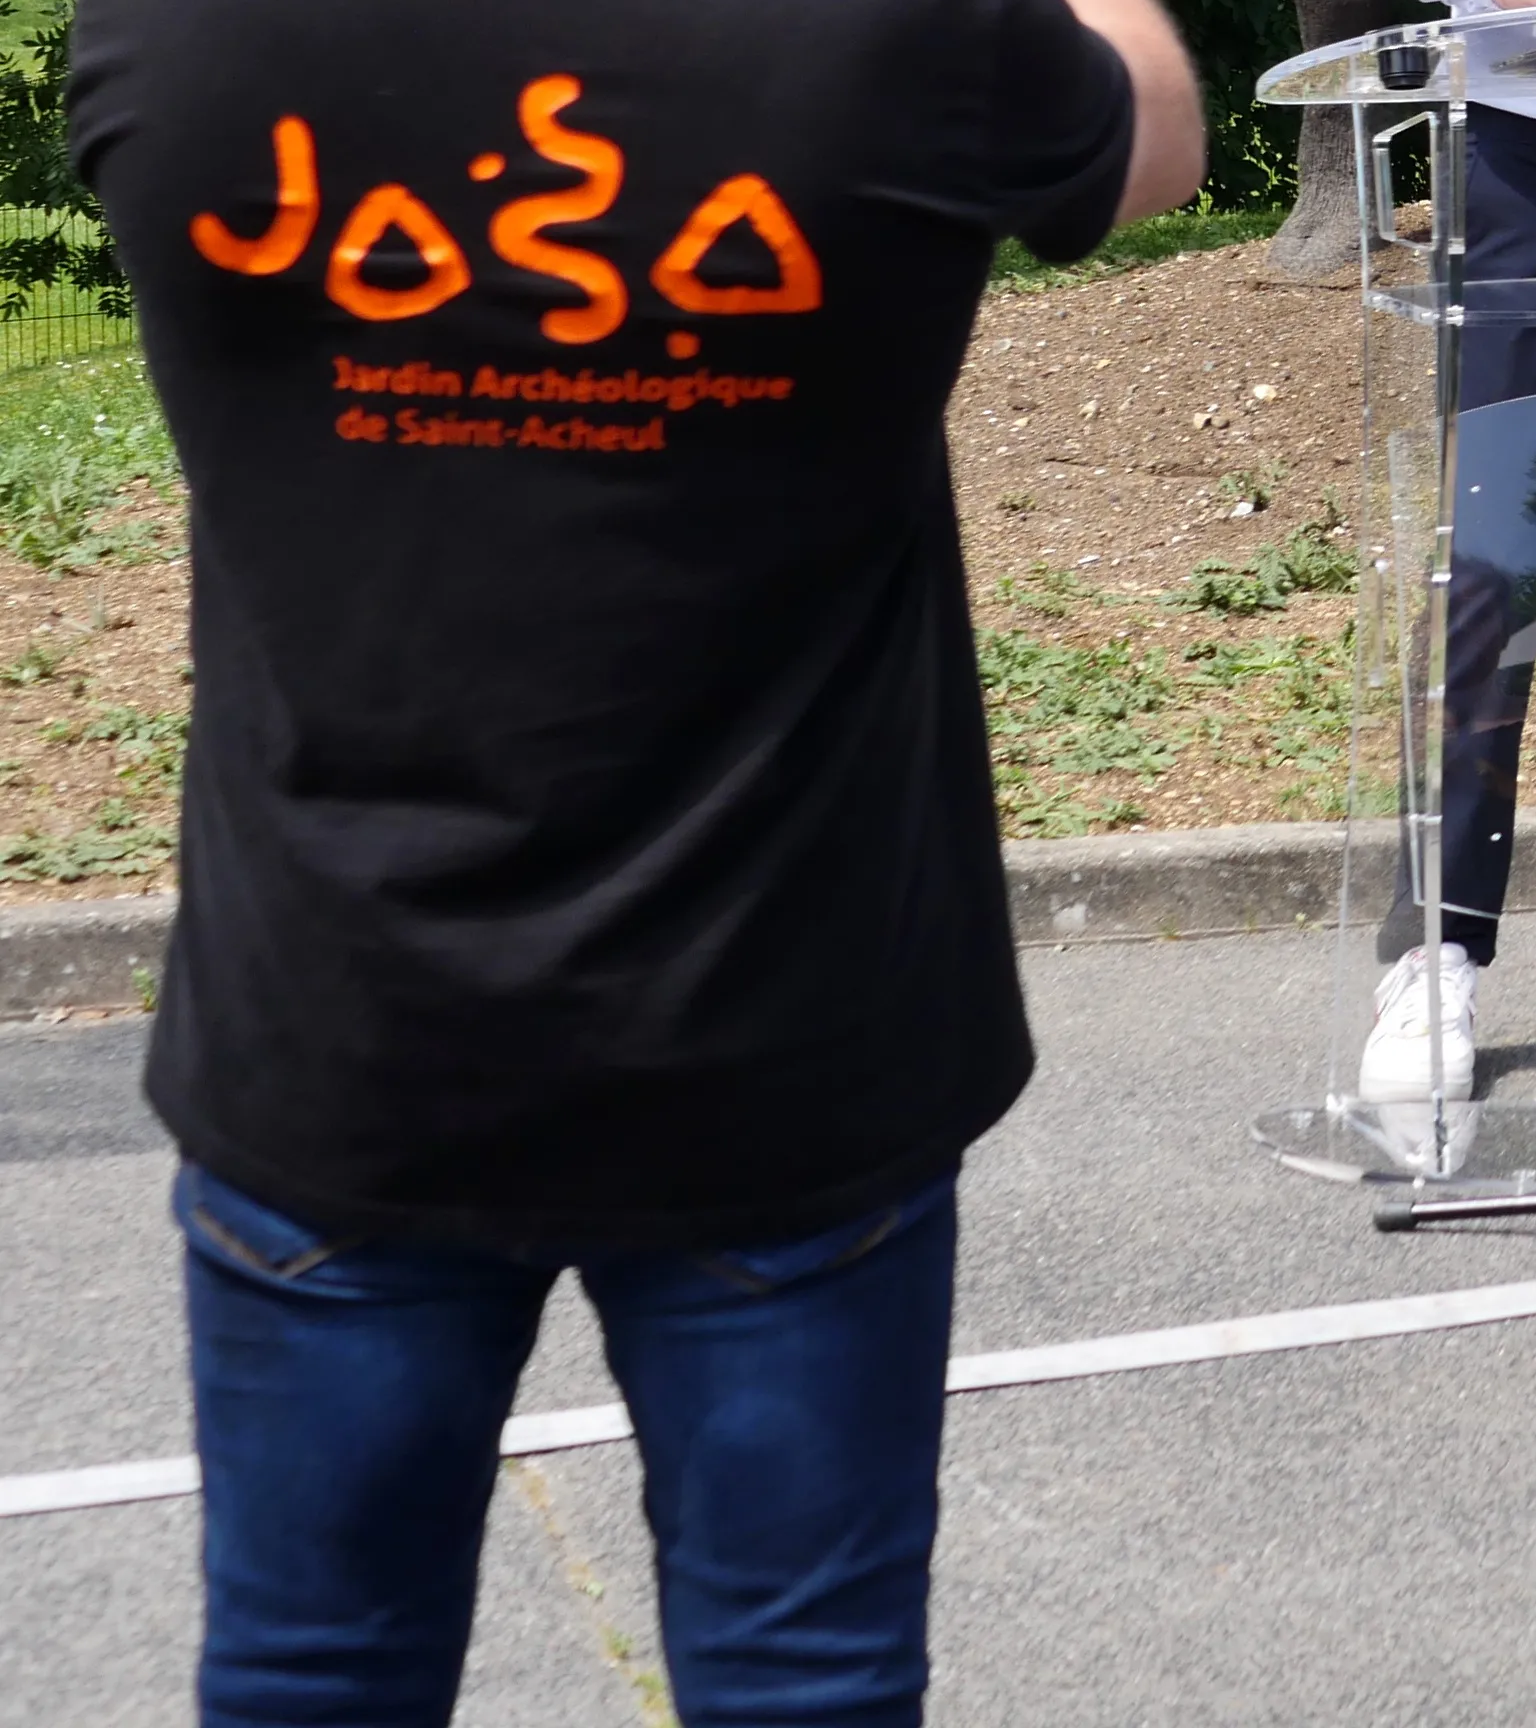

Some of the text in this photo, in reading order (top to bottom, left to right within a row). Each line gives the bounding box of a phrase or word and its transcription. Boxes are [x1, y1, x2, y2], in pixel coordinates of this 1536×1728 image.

[331, 355, 796, 411] Jardin Archéologique
[334, 405, 666, 452] de Saint-Acheul
